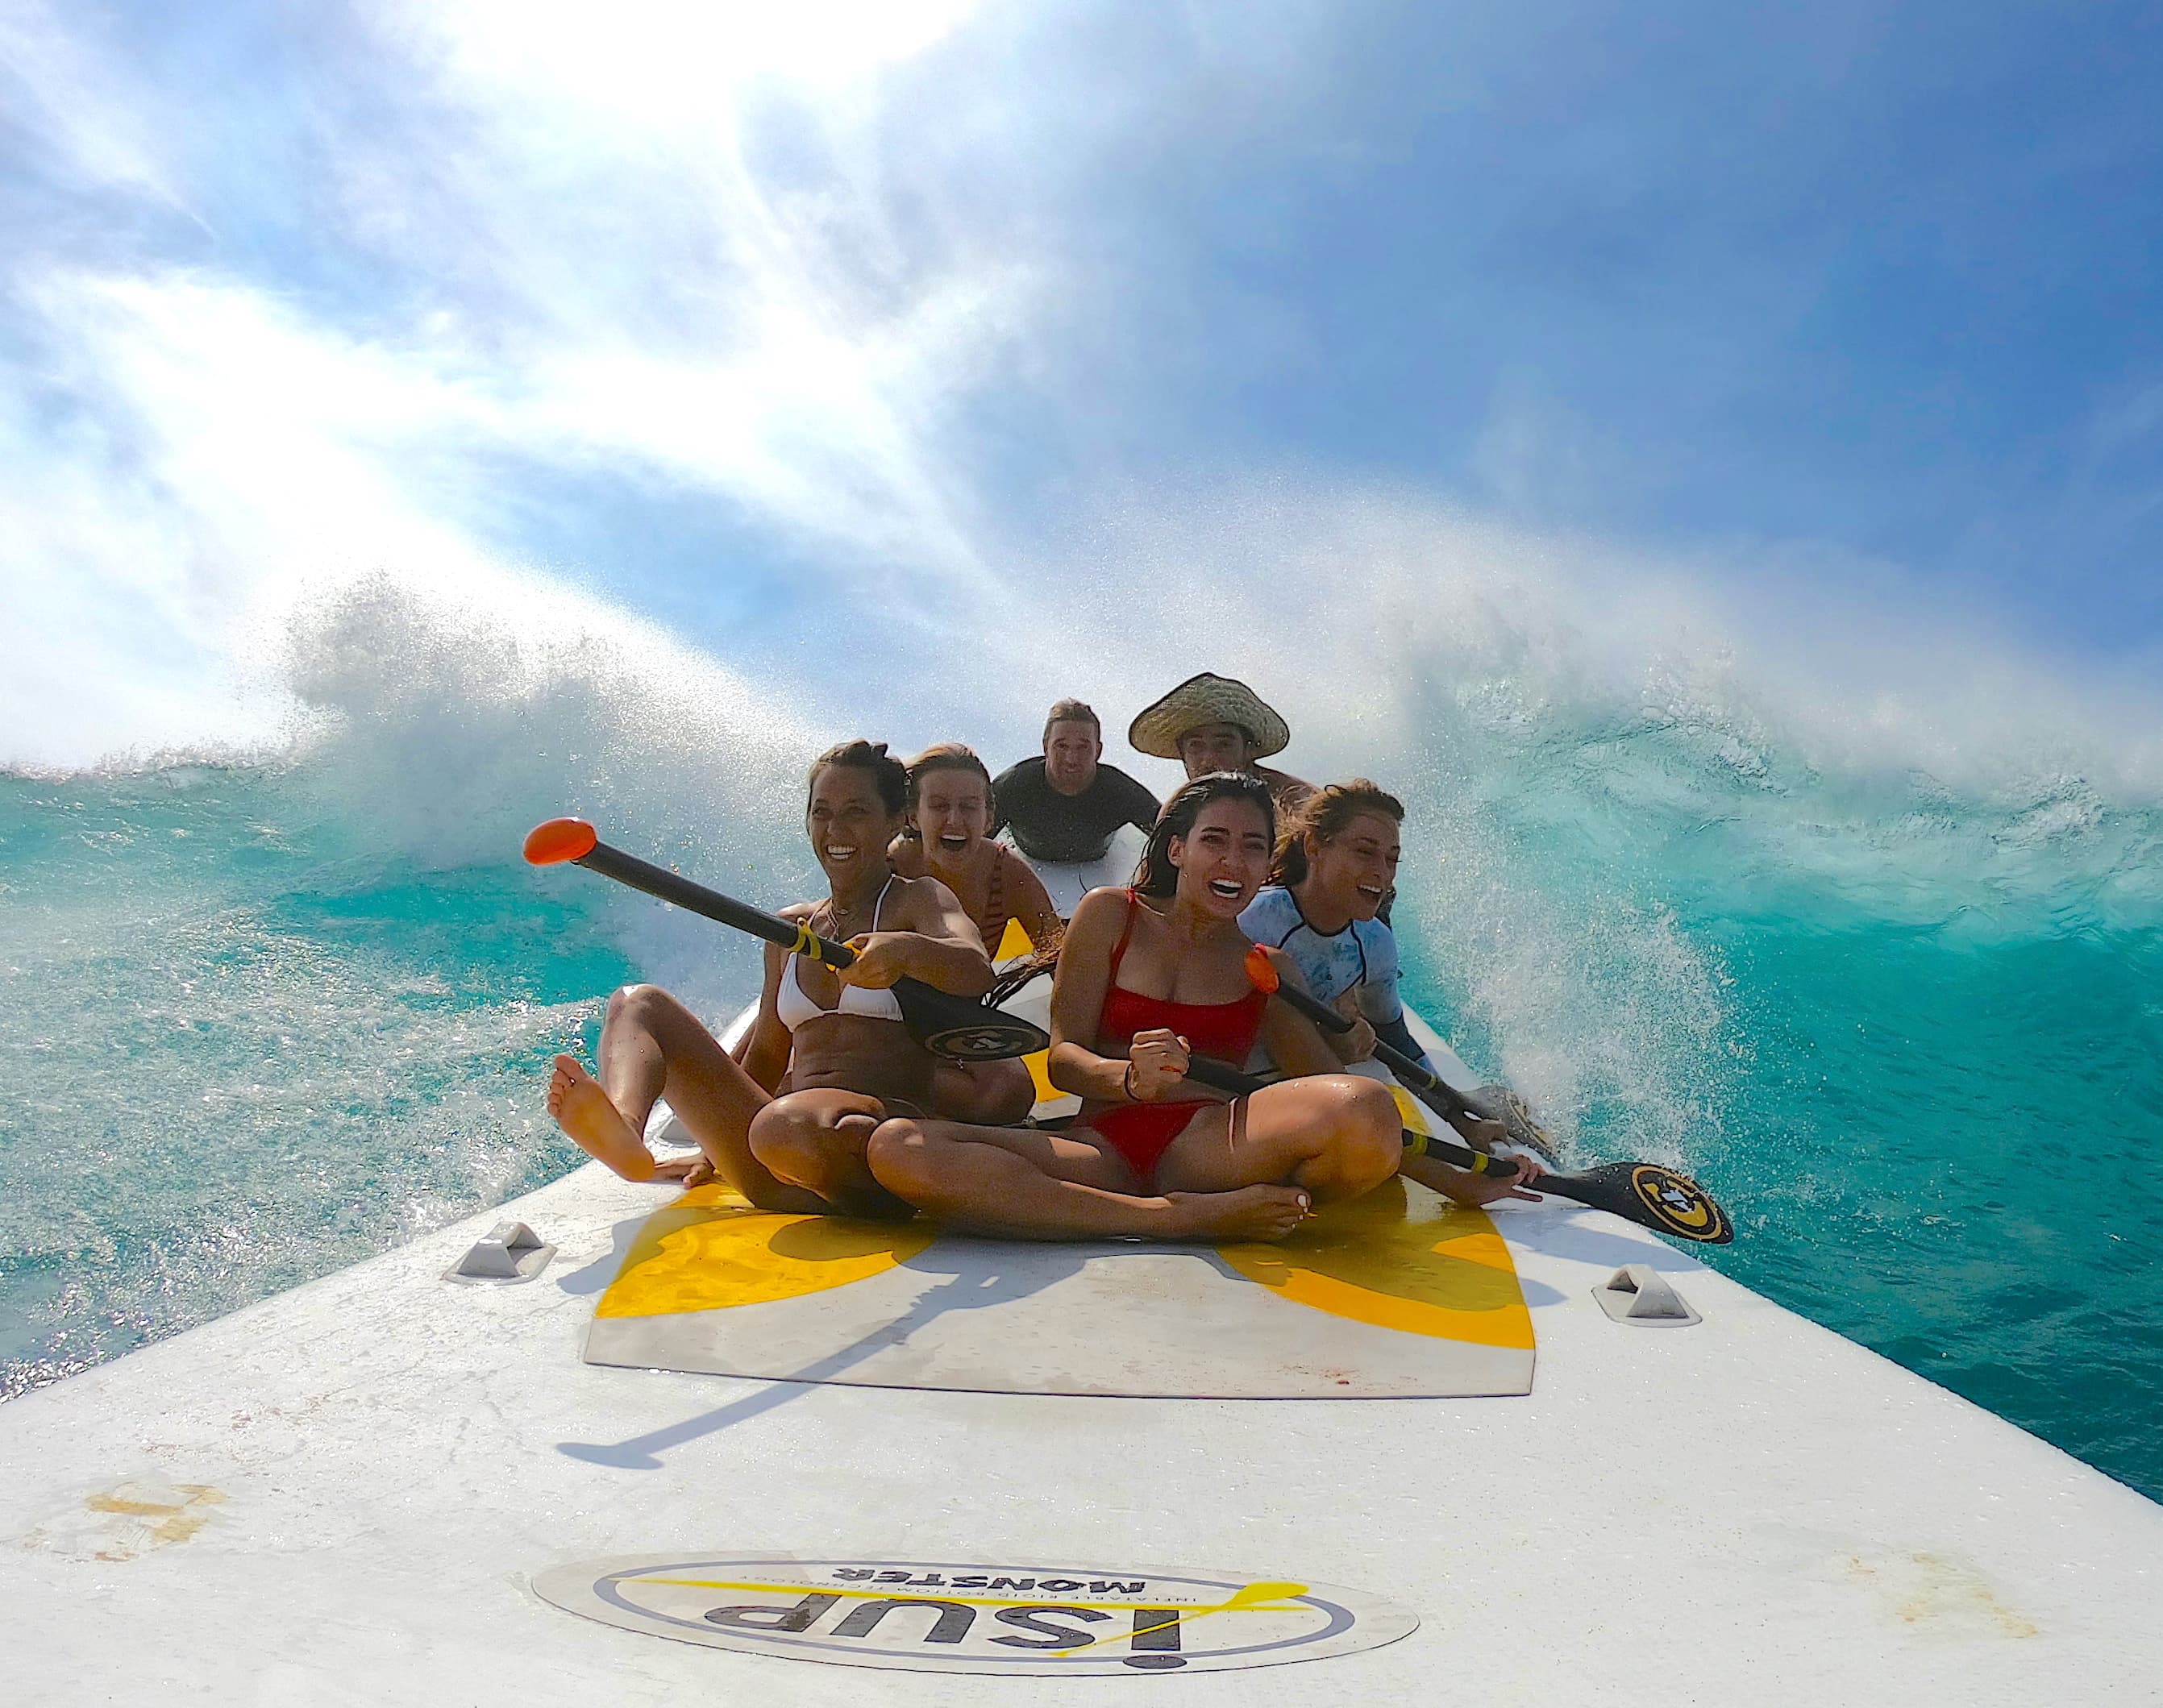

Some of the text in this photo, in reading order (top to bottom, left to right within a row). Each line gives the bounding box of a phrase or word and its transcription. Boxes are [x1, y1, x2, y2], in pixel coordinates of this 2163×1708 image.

[738, 1576, 884, 1591] TECHNOLOGY
[833, 1568, 1146, 1594] MONSTER
[897, 1588, 985, 1596] BOTTOM
